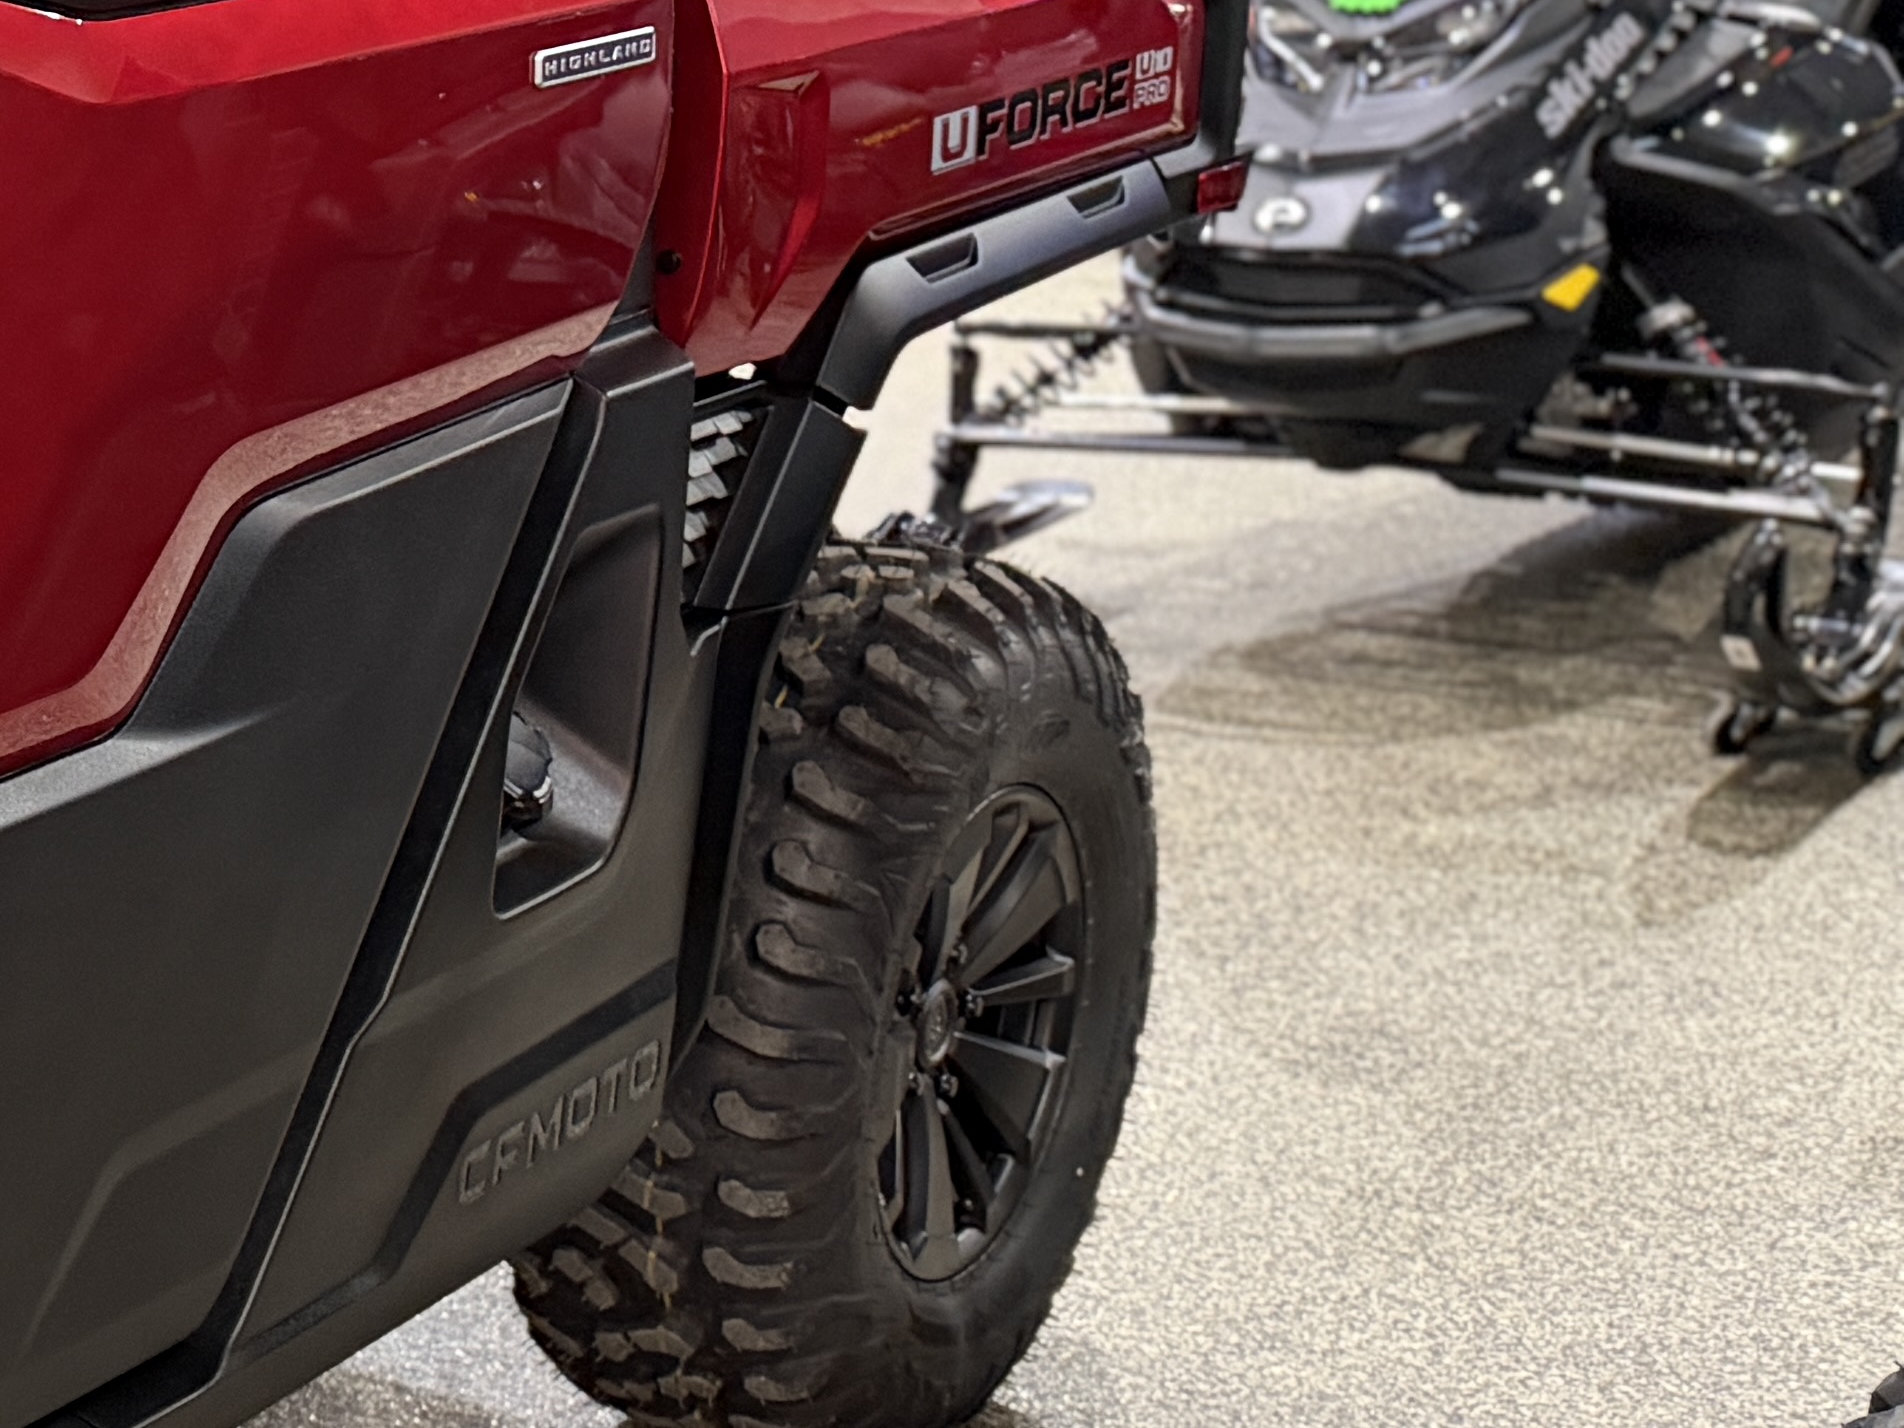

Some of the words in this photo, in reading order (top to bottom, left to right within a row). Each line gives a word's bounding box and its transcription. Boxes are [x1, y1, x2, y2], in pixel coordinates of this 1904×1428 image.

[544, 38, 651, 77] HIGHLAND
[1135, 45, 1174, 80] U10
[1133, 75, 1171, 109] PRO
[458, 1039, 660, 1204] CFMOTO
